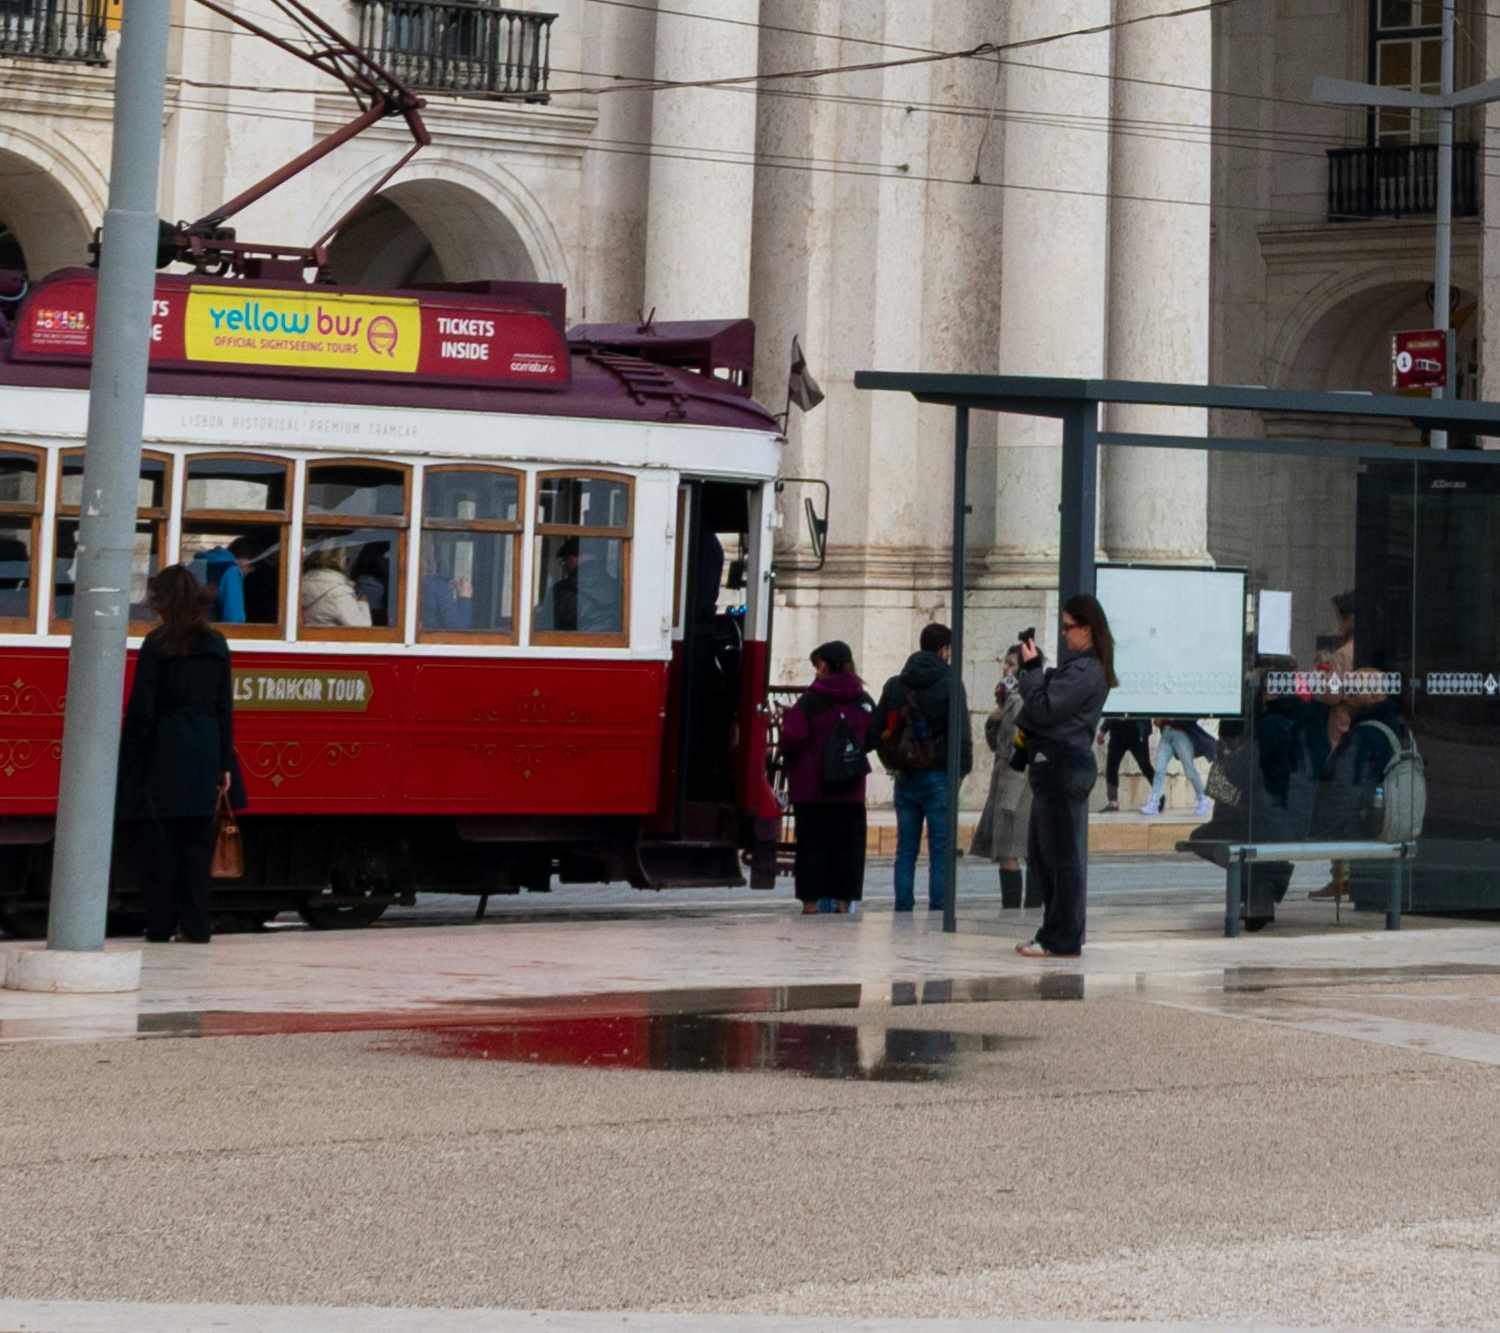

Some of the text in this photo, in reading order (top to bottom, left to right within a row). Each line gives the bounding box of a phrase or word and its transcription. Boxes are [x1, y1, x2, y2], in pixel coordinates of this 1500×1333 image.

[317, 306, 362, 336] bus
[437, 317, 495, 337] TICKETS
[214, 336, 358, 354] OFFICIAL SIGHTSEEING TOURS
[441, 341, 489, 360] INSIDE
[181, 416, 417, 437] LISBON HISTORICAL PREMIUM TRAMCAR
[257, 677, 322, 700] TRAMCAR
[327, 679, 365, 700] TOUR
